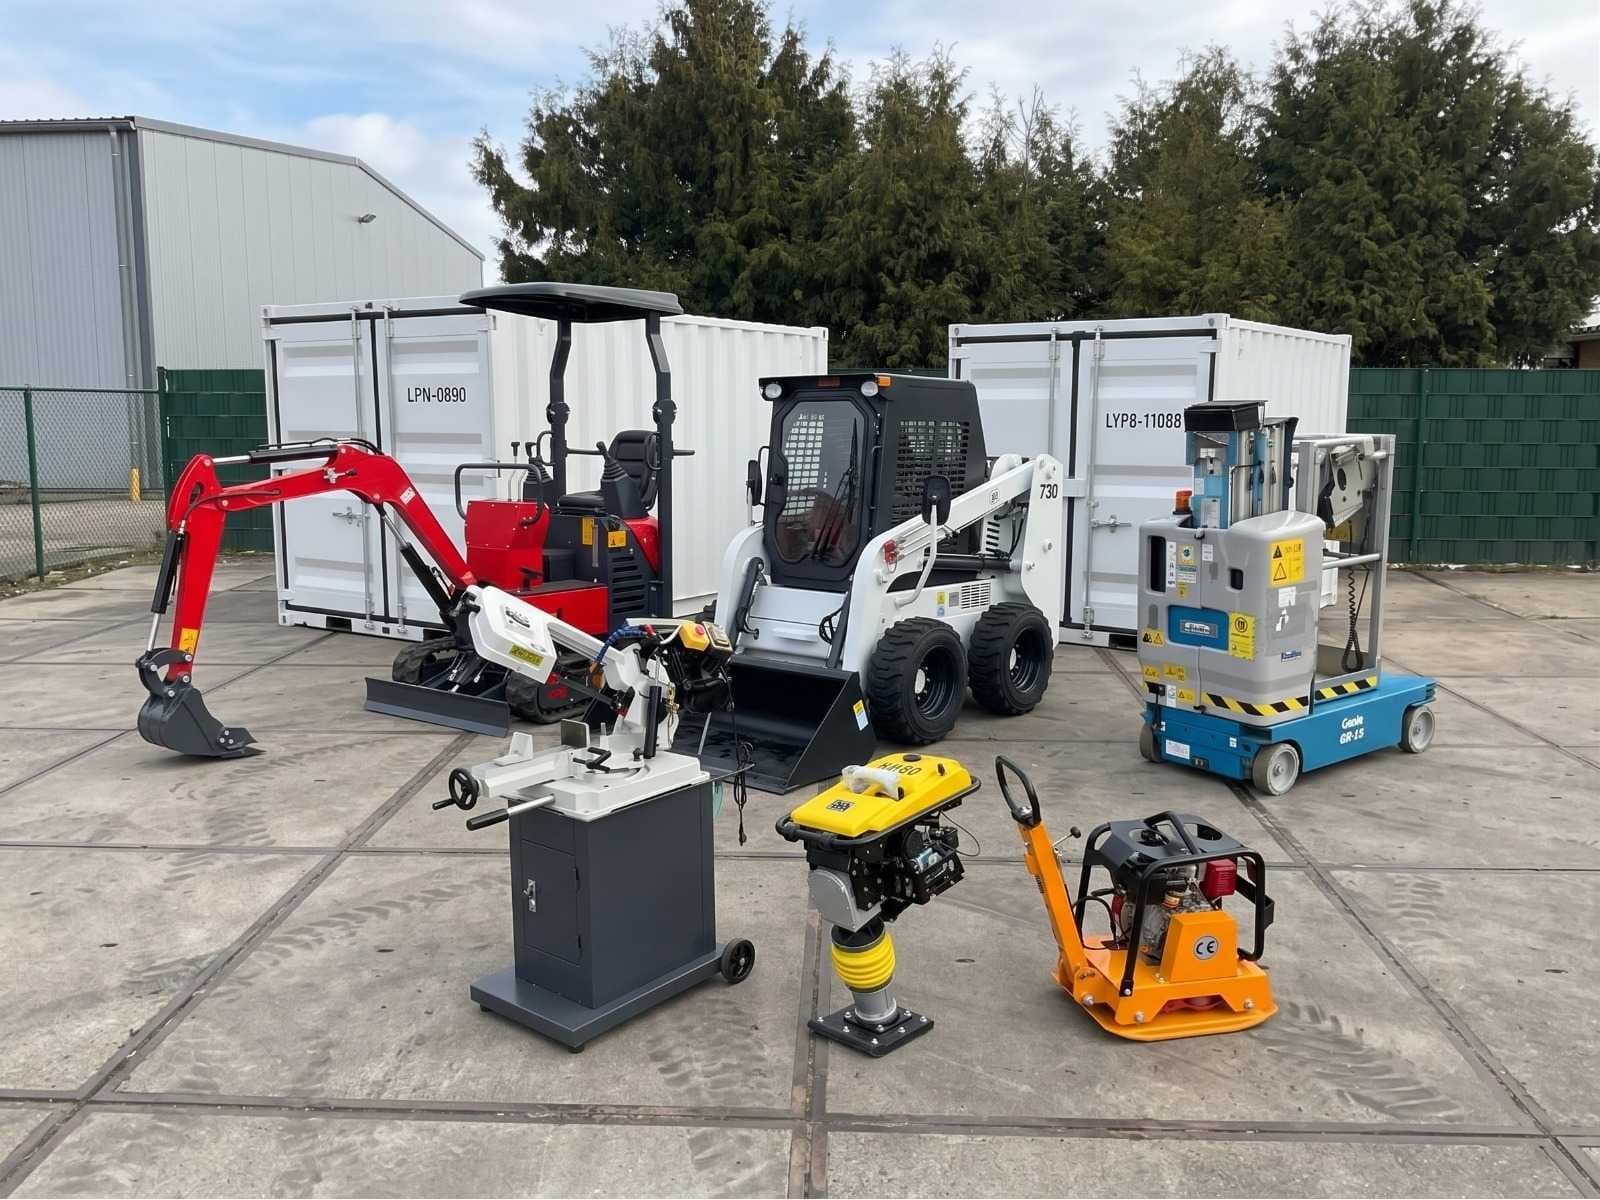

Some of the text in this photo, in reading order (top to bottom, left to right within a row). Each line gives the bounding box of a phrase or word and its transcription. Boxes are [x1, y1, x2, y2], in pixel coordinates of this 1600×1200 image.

[407, 387, 466, 402] LPN-0890
[1105, 412, 1182, 428] LYP8-11088
[1040, 483, 1058, 499] 730
[1195, 940, 1218, 955] CE
